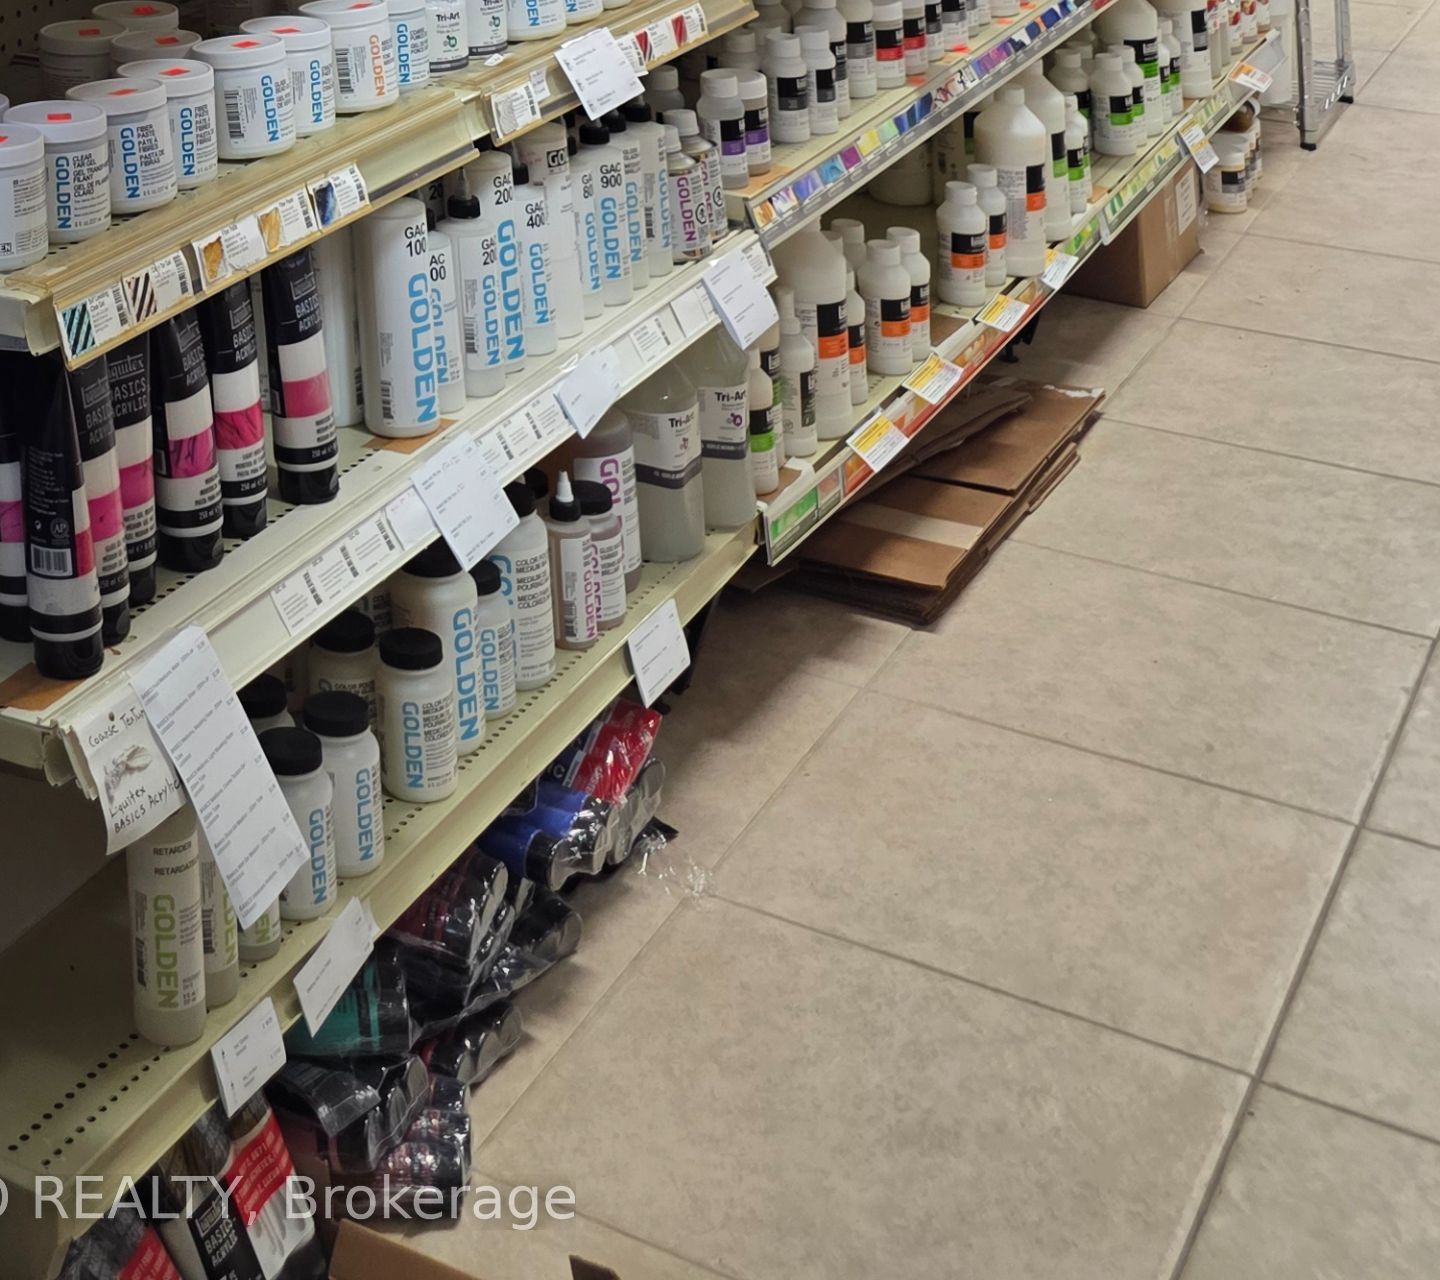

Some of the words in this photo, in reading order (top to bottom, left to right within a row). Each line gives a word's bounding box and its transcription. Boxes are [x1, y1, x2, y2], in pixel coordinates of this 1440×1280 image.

[370, 34, 386, 97] GOLDEN
[261, 74, 280, 143] GOLDEN
[55, 156, 71, 229] GOLDEN
[600, 173, 622, 188] 900
[408, 272, 438, 424] GOLDEN
[402, 701, 424, 790] GOLDEN
[309, 808, 328, 906] GOLDEN
[152, 893, 179, 1010] GOLDEN
